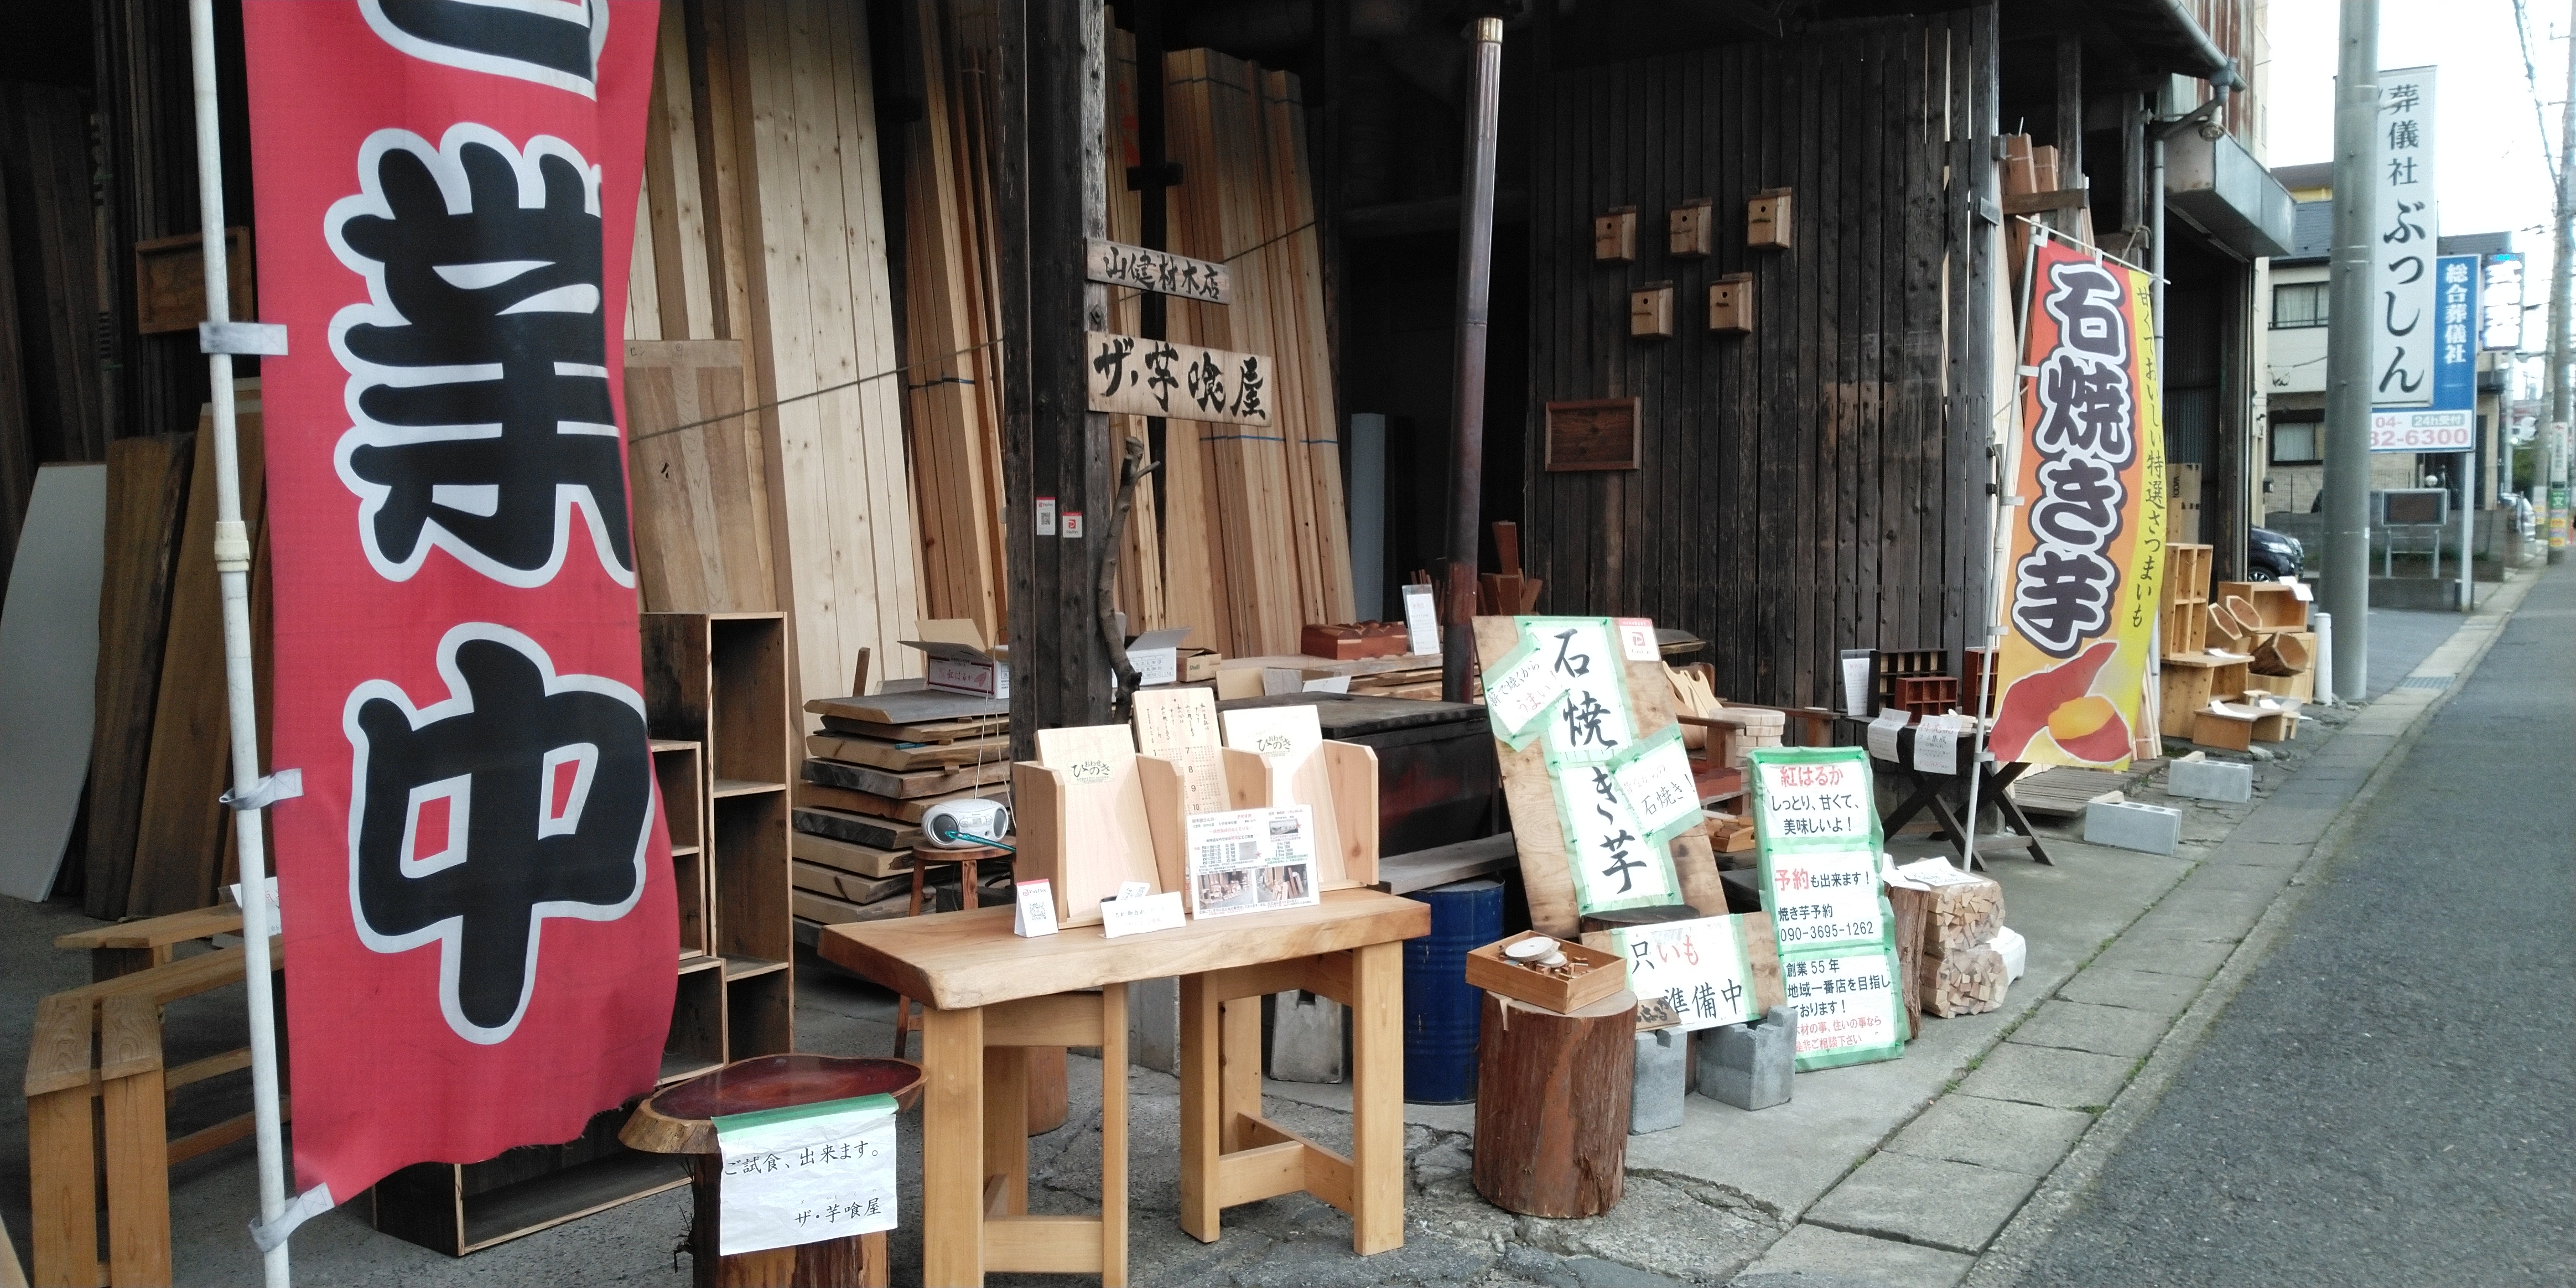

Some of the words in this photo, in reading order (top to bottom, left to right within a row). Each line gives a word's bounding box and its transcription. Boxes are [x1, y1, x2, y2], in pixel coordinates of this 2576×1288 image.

[2387, 84, 2419, 186] 葬儀社
[2378, 198, 2426, 394] ぶっしん
[2444, 263, 2469, 365] 総合葬儀社
[2014, 262, 2131, 655] 石焼き芋
[2132, 287, 2165, 629] 甘くておいしい特選さつまいも
[1780, 766, 1844, 787] 紅はるか
[1772, 794, 1860, 812] しっとり、甘くて、
[1783, 817, 1852, 836] 美味しいよ！
[1775, 868, 1870, 892] 予約も出来ます！
[1778, 903, 1833, 922] 焼き芋予約
[1780, 921, 1874, 943] 090-3695-1262
[1786, 961, 1808, 978] 創業
[1811, 960, 1826, 974] 55
[1829, 958, 1840, 973] 年
[1787, 974, 1891, 998] 地域一番店を目指し
[1636, 997, 1670, 1024] はるか
[724, 1140, 879, 1176] ご試食、出来ます。
[794, 1197, 882, 1228] ザ・芋喰屋
